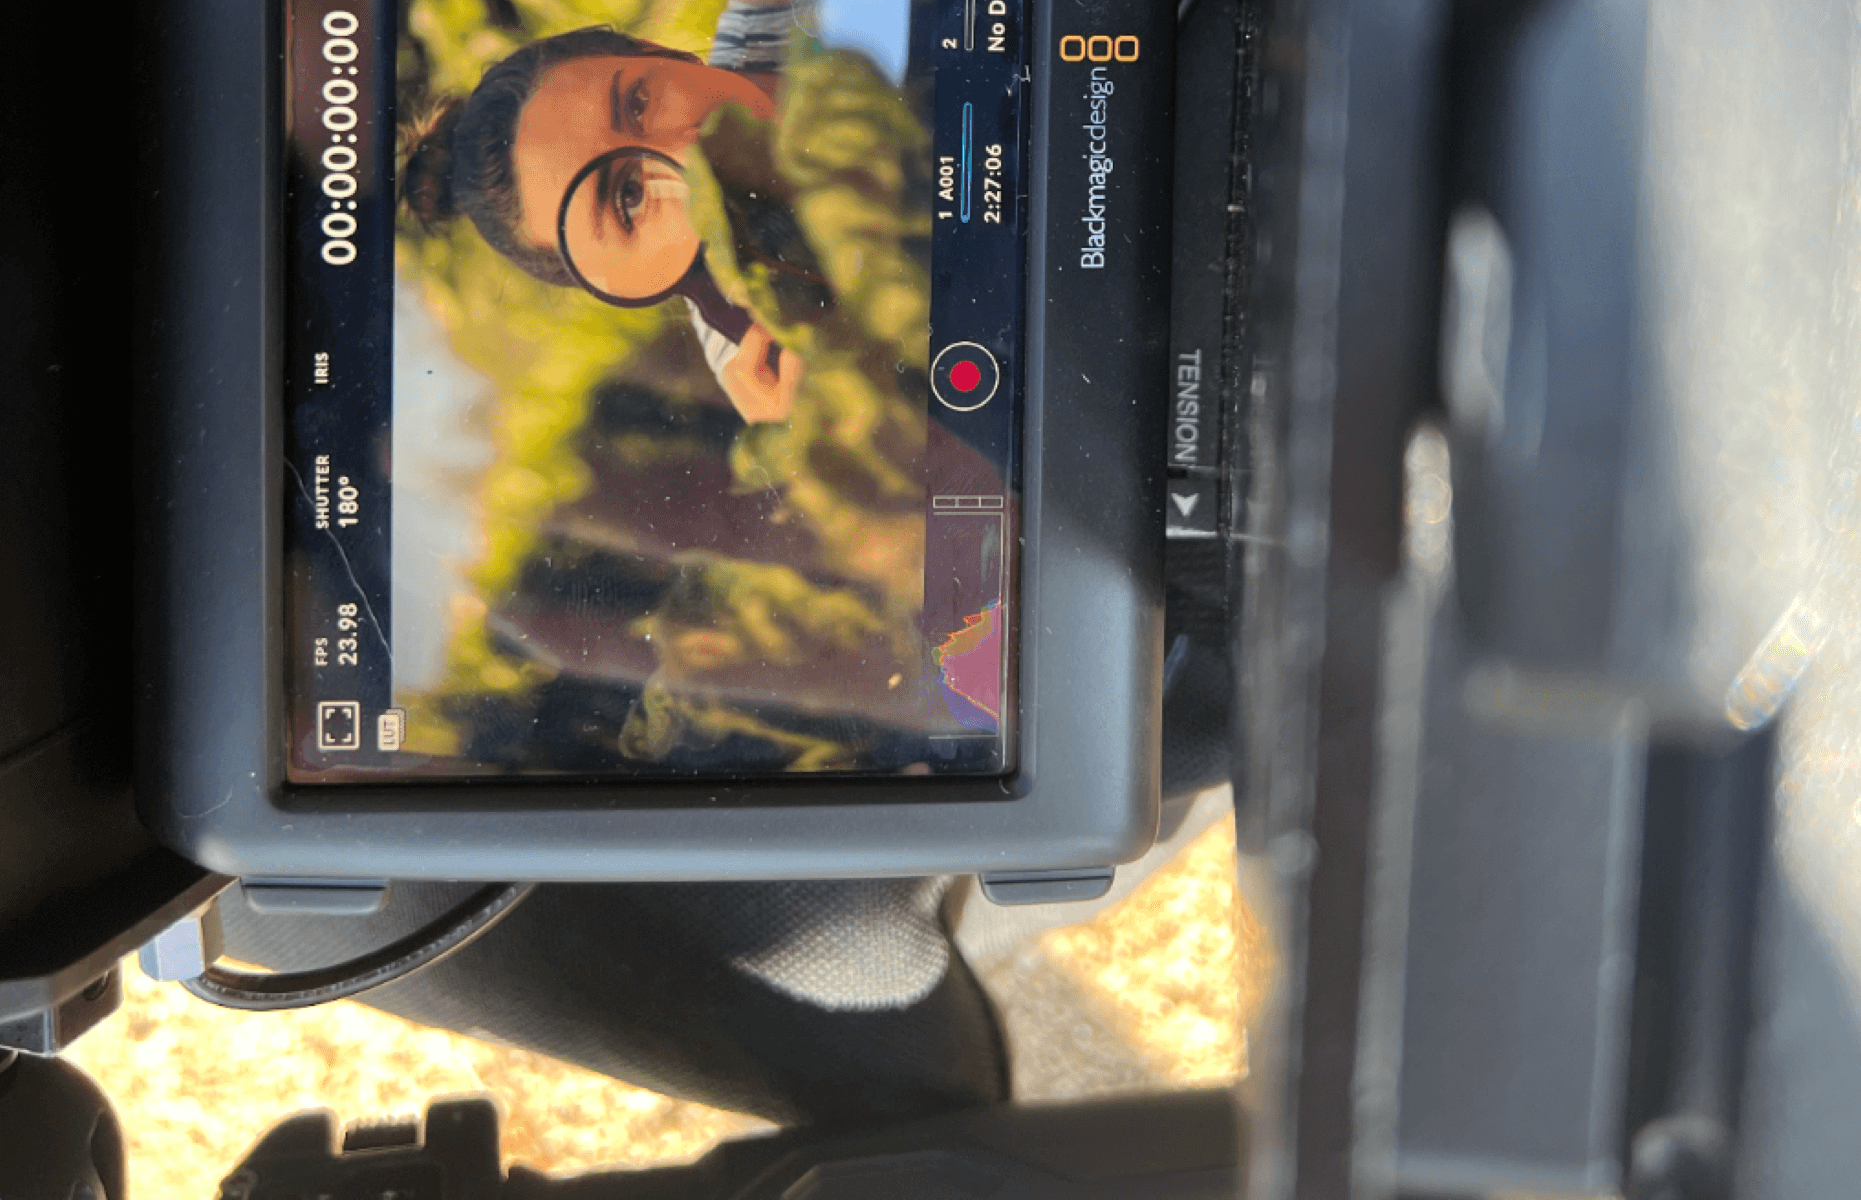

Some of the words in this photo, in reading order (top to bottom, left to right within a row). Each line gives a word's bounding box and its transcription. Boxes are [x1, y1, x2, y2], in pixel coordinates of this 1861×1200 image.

[942, 37, 957, 49] 2
[988, 23, 1005, 52] No
[320, 10, 359, 265] 00:00:00:00
[939, 156, 954, 201] A001
[984, 144, 1002, 223] 2:27:06
[1081, 66, 1114, 269] Blackmagicdesign
[939, 211, 953, 219] 1
[314, 352, 330, 384] IRIS
[1176, 348, 1202, 465] TENSION
[315, 455, 330, 530] SHUTTER
[337, 475, 360, 528] 180°
[314, 637, 328, 666] FPS
[338, 603, 358, 666] 23.98
[383, 719, 396, 745] LUT
